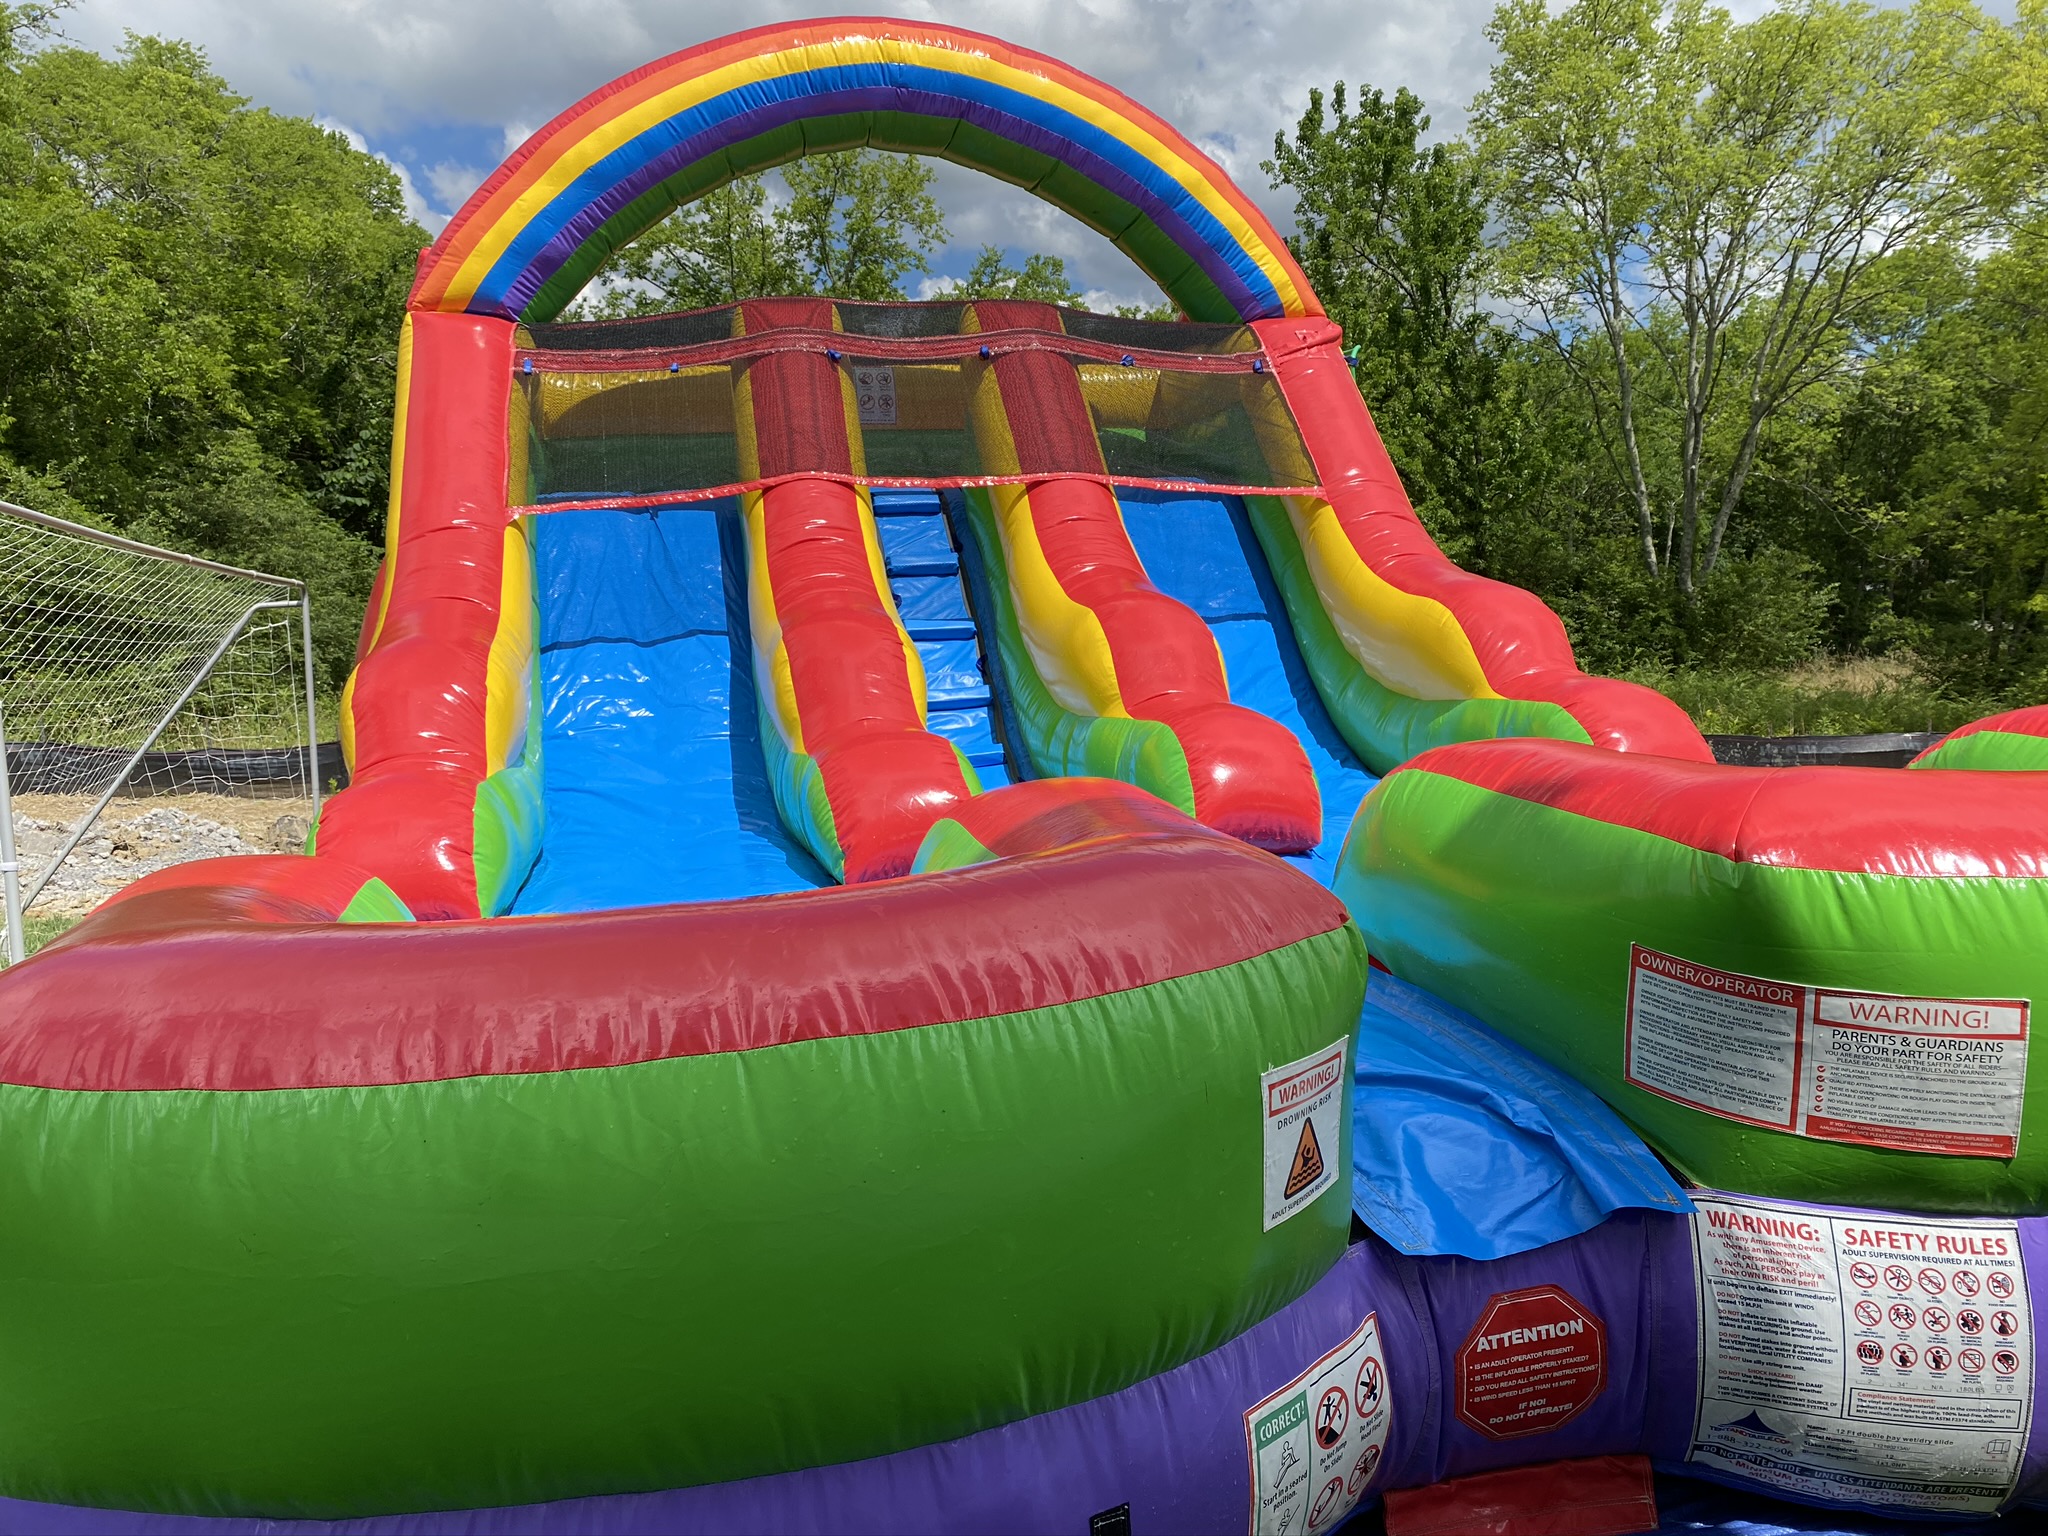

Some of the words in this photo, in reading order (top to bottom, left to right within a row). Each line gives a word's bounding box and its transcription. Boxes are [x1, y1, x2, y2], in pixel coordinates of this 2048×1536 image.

[1640, 953, 1793, 1003] OWNER/OPERATOR
[1849, 1002, 1989, 1029] WARNING!
[1833, 1030, 1896, 1046] PARENTS
[1901, 1037, 1911, 1047] &
[1915, 1037, 2004, 1052] GUARDIANS
[1833, 1042, 1852, 1051] DO
[1854, 1045, 1889, 1056] YOUR
[1893, 1049, 1923, 1060] PART
[1927, 1052, 1952, 1061] FOR
[1955, 1054, 2003, 1064] SAFETY
[1853, 1054, 1897, 1063] RESPONSIBLE
[1279, 1064, 1334, 1104] WARNING!
[1278, 1101, 1318, 1130] DROWNING
[1319, 1092, 1332, 1105] RISK
[1271, 1206, 1287, 1220] ADULT
[1706, 1210, 1820, 1242] WARNING:
[1718, 1232, 1733, 1240] with
[1735, 1235, 1748, 1243] any
[1751, 1235, 1796, 1249] Amusement
[1723, 1242, 1743, 1250] there
[1762, 1248, 1795, 1258] inherent
[1844, 1228, 1929, 1251] SAFETY
[1937, 1235, 2008, 1256] RULES
[1742, 1254, 1775, 1264] personal
[1842, 1249, 1867, 1257] ADULT
[1869, 1251, 1920, 1261] SUPERVISION
[1922, 1256, 1962, 1265] REQUIRED
[1721, 1268, 1739, 1276] their
[1741, 1271, 1760, 1279] OWN
[1762, 1274, 1779, 1282] RISK
[1781, 1277, 1796, 1285] and
[1761, 1265, 1797, 1276] PERSONS
[1799, 1270, 1816, 1280] play
[1727, 1281, 1747, 1290] begins
[1756, 1286, 1778, 1294] deflate
[1477, 1319, 1584, 1352] ATTENTION
[1491, 1358, 1509, 1367] ADULT
[1511, 1352, 1542, 1362] OPERATOR
[1543, 1346, 1574, 1356] PRESENT?
[1495, 1366, 1529, 1378] INFLATABLE
[1530, 1360, 1561, 1370] PROPERLY
[1562, 1355, 1589, 1364] STAKED?
[1500, 1379, 1516, 1388] READ
[1529, 1373, 1552, 1382] SAFETY
[1553, 1364, 1598, 1377] INSTRUCTIONS?
[1498, 1391, 1518, 1399] SPEED
[1529, 1398, 1546, 1408] NO!
[1858, 1392, 1897, 1401] Compliance
[1260, 1400, 1305, 1441] CORRECT!
[1489, 1416, 1503, 1424] DO
[1505, 1412, 1525, 1421] NOT
[1527, 1403, 1572, 1417] OPERATE!
[1359, 1424, 1366, 1433] Do
[1857, 1432, 1885, 1440] double
[1319, 1457, 1326, 1466] Do
[1324, 1463, 1330, 1472] On
[1720, 1450, 1741, 1459] NOT
[1814, 1472, 1854, 1484] UNLESS
[1856, 1479, 1923, 1492] ATTENDANTS
[1927, 1485, 1947, 1493] ARE
[1949, 1487, 2000, 1496] PRESENT!
[1263, 1494, 1278, 1509] Start
[1289, 1470, 1308, 1489] seated
[1273, 1491, 1297, 1513] position.
